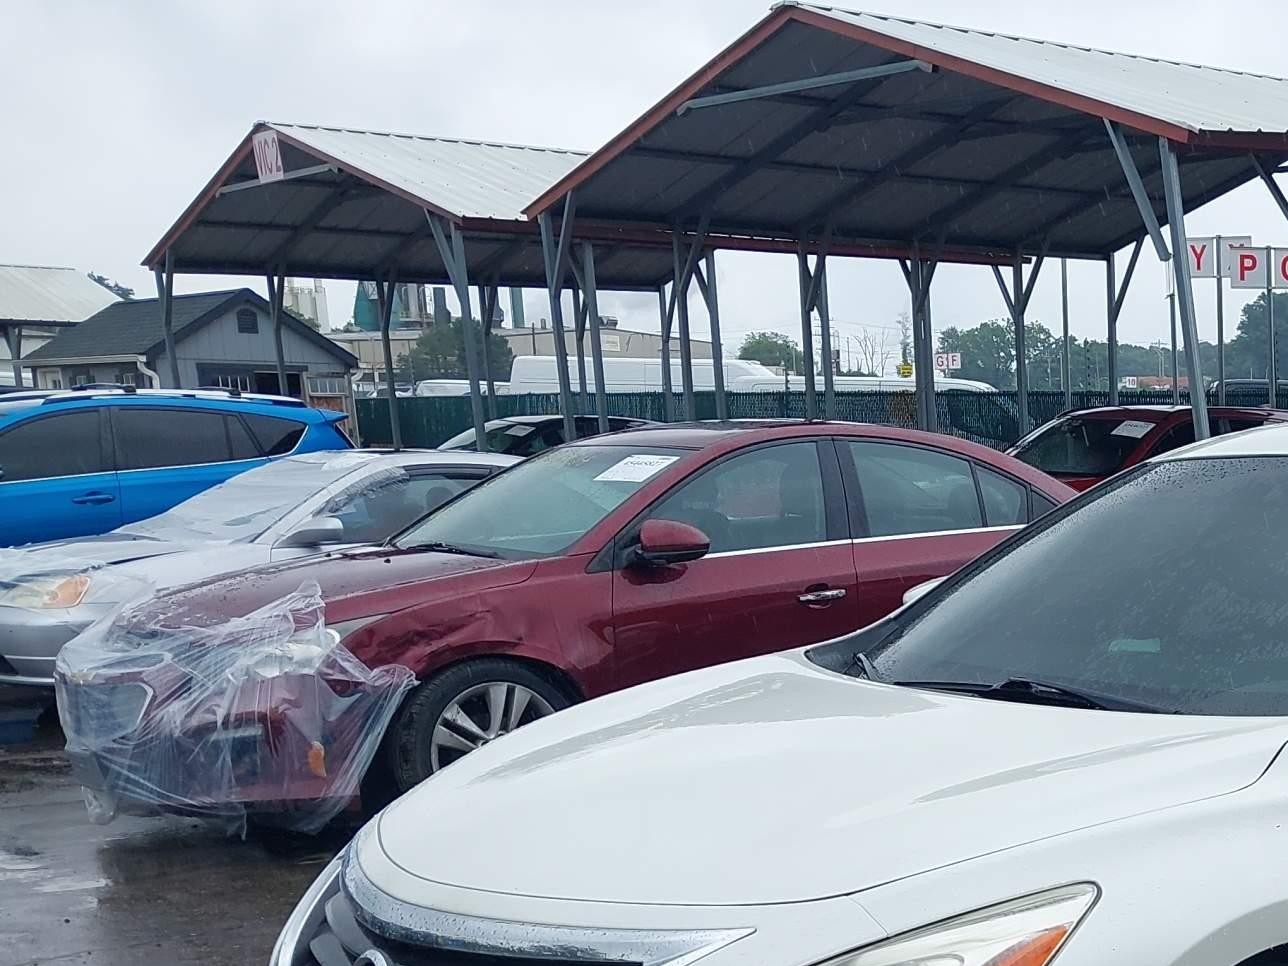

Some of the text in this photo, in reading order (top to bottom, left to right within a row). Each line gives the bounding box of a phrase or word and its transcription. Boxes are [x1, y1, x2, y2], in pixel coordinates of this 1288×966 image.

[1189, 245, 1207, 271] Y
[1239, 254, 1257, 281] P
[937, 355, 944, 367] G
[951, 354, 957, 366] F
